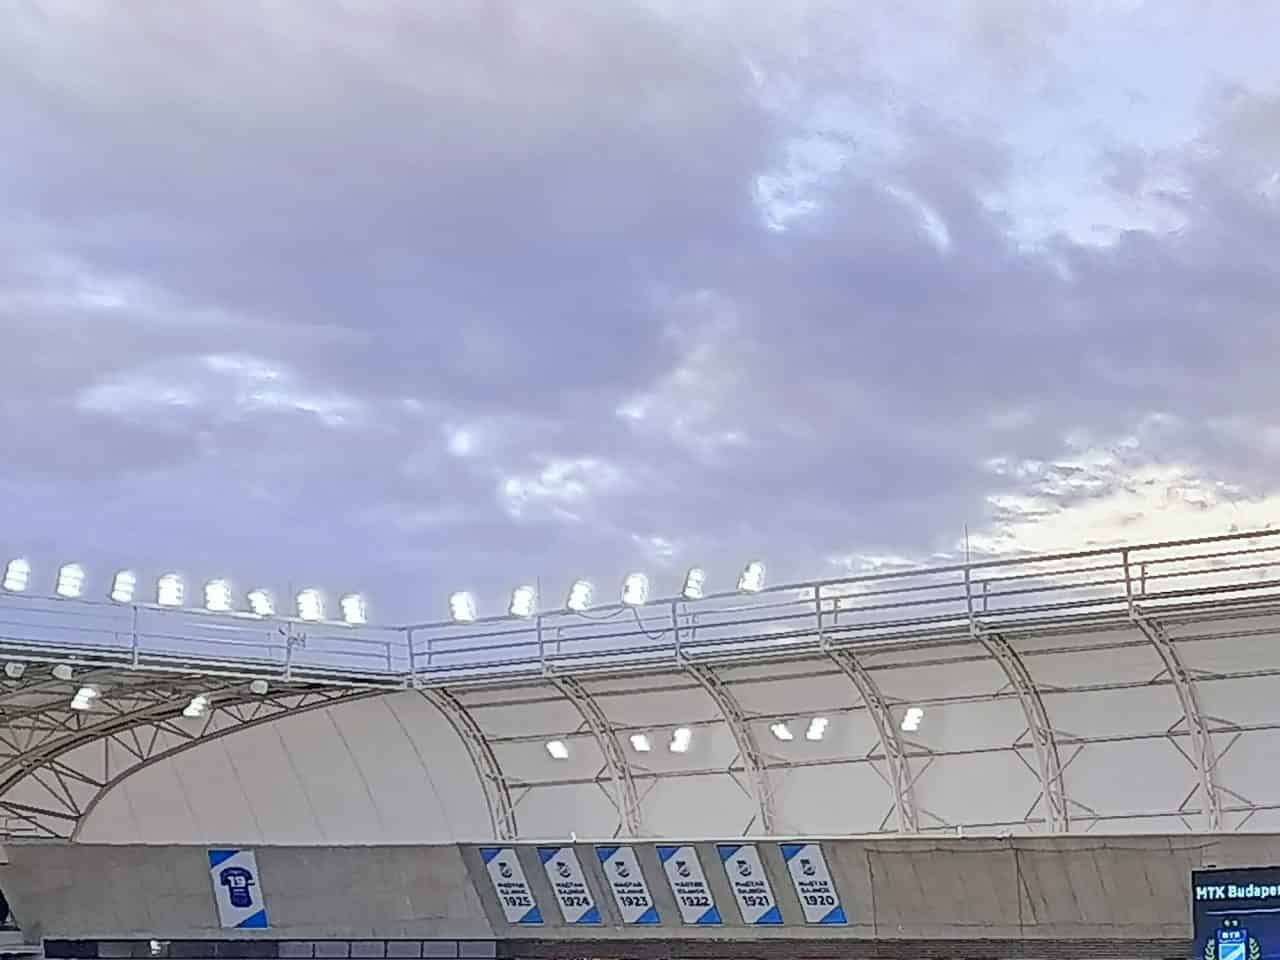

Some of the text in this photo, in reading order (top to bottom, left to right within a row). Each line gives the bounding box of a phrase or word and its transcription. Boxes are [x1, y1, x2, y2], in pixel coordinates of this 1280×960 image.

[227, 876, 246, 888] 19
[1196, 886, 1225, 900] MTK
[504, 896, 532, 907] 1925
[561, 896, 591, 907] 1924
[620, 896, 648, 907] 1923
[681, 895, 710, 907] 1922
[743, 895, 770, 906] 1921
[805, 895, 834, 906] 1920
